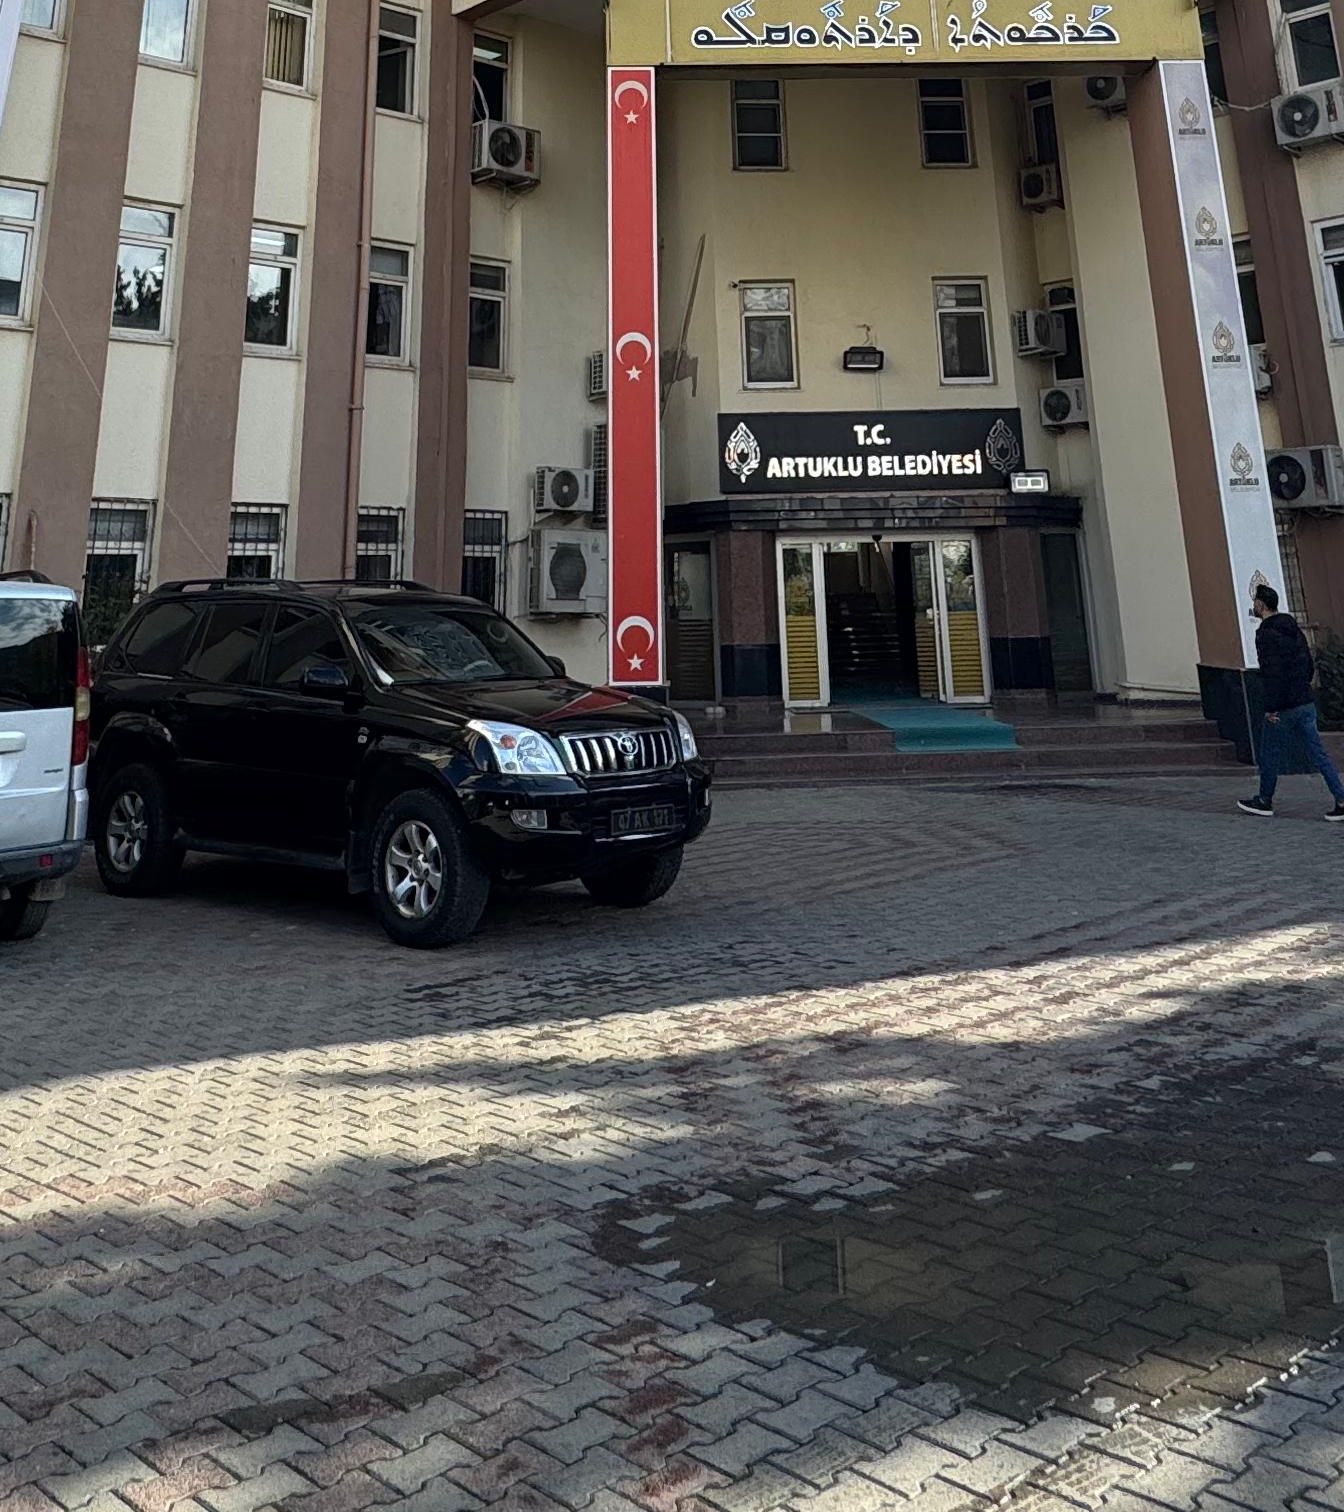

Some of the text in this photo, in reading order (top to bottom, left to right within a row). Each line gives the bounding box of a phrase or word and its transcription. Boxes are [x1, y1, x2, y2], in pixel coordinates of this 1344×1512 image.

[853, 424, 892, 446] T.C.
[766, 449, 983, 478] ARTUKLU BELEDİYESİ
